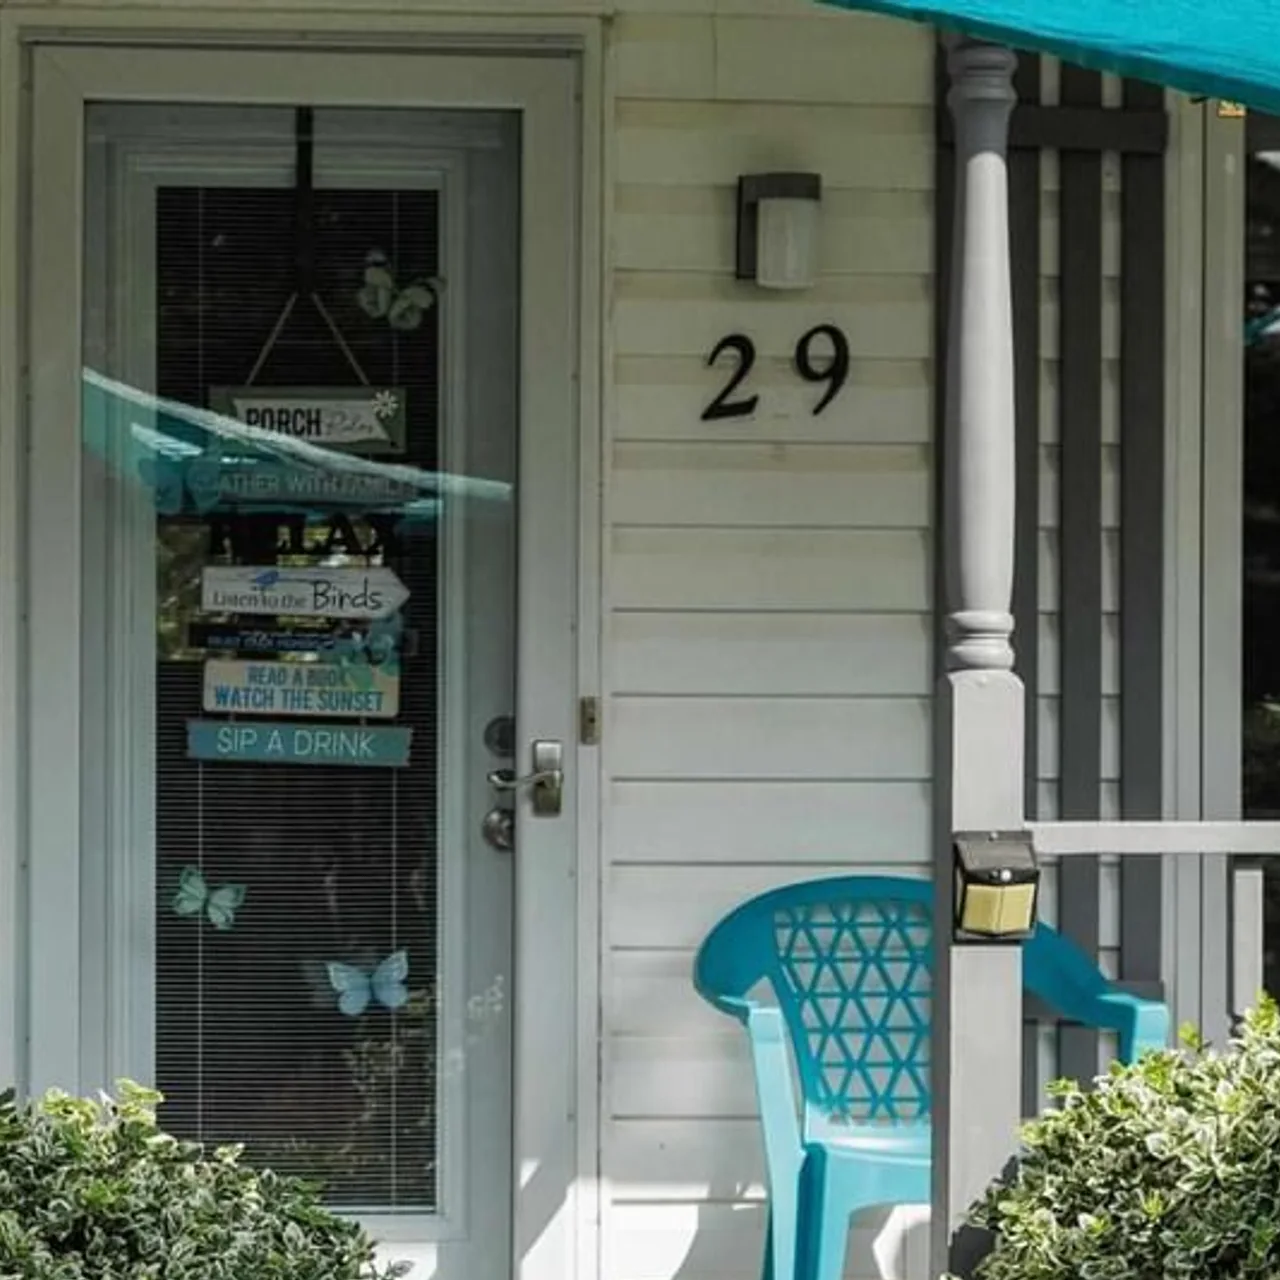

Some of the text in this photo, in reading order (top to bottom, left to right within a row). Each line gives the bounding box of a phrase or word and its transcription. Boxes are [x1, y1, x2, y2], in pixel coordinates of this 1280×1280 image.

[700, 323, 850, 421] 29
[245, 407, 322, 436] PORCH
[312, 577, 384, 611] Birds
[247, 666, 286, 686] READ
[291, 667, 305, 687] A
[214, 685, 384, 712] WATCH THE SUNSET
[216, 727, 376, 757] SIP A DRINK
